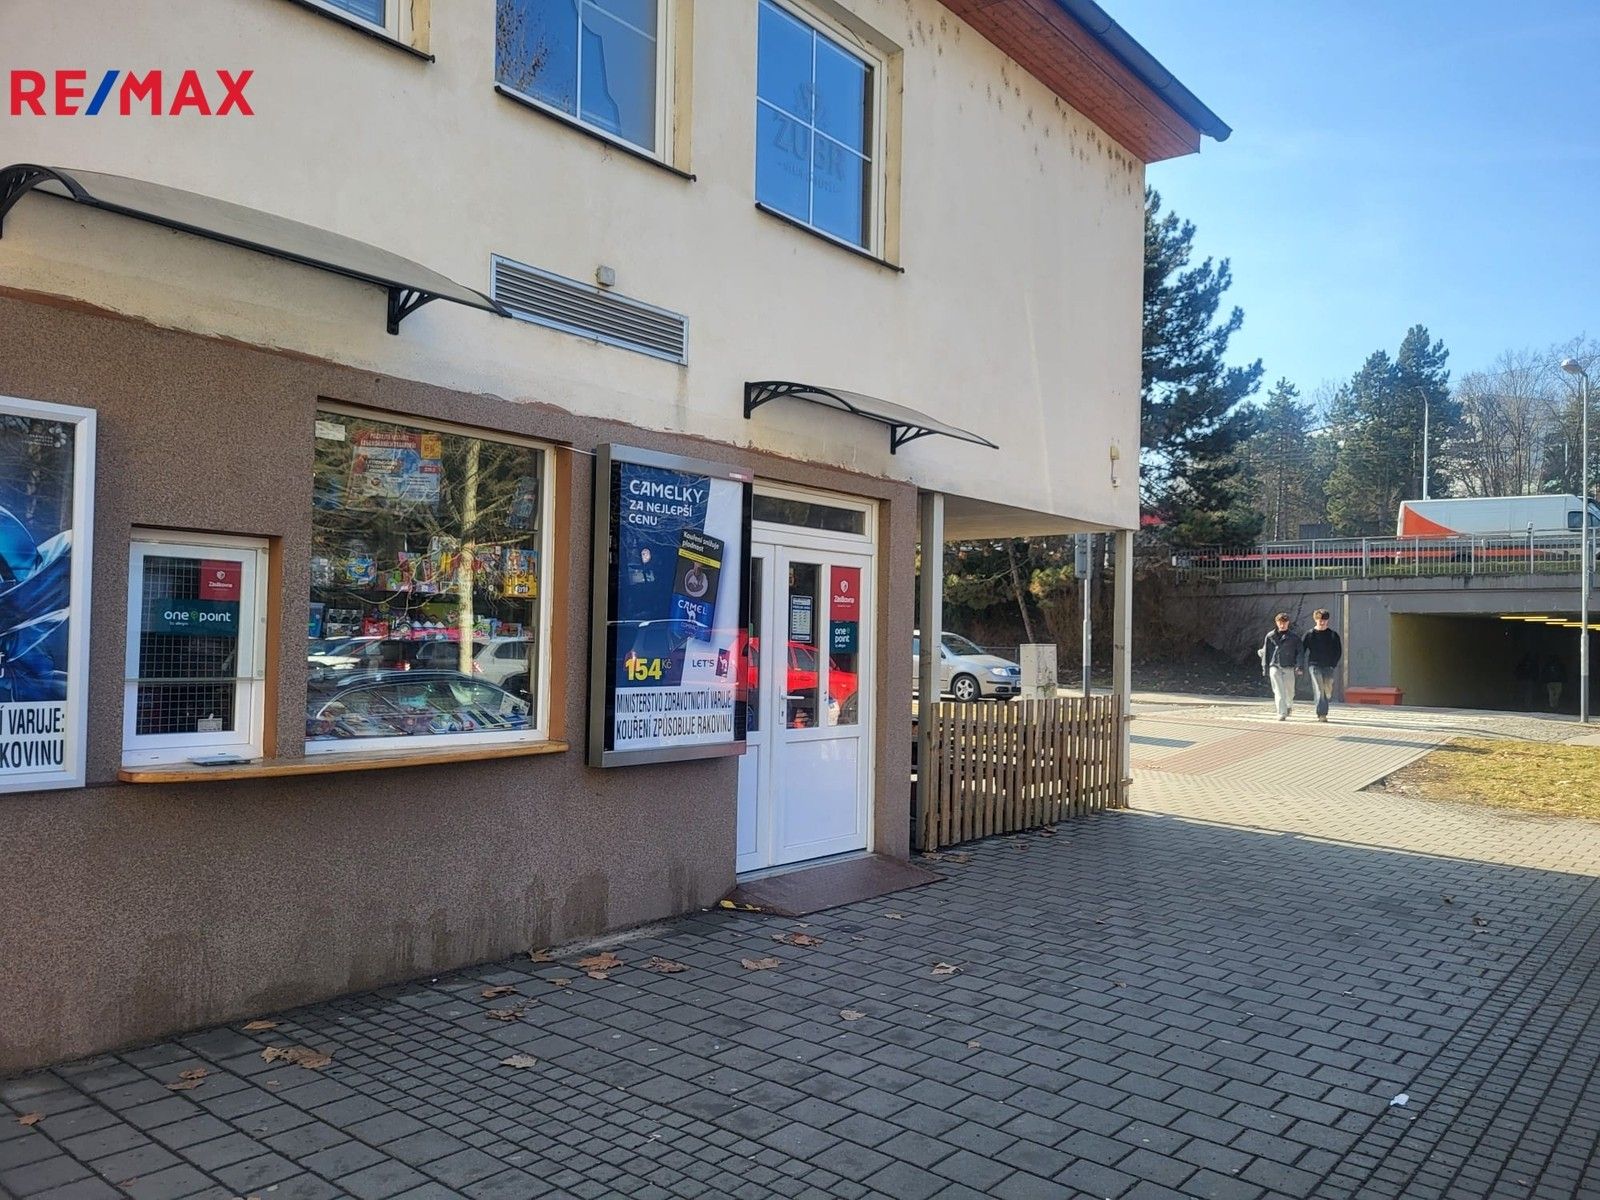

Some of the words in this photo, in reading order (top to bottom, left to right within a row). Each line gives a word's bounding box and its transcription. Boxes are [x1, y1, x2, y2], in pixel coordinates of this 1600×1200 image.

[629, 479, 704, 504] CAMELKY
[629, 500, 643, 511] ZA
[646, 503, 693, 517] NEJLEPŠÍ
[628, 513, 658, 526] CENU
[677, 599, 708, 615] CAMEL
[164, 610, 189, 621] one
[199, 611, 232, 622] point
[834, 635, 850, 643] point
[625, 658, 663, 681] 154
[662, 659, 672, 669] Kč
[692, 659, 715, 668] LET'S
[616, 693, 663, 713] MINISTERSTVO
[664, 687, 710, 711] ZDRAVOTNICTVÍ
[8, 707, 65, 735] VARUJE:
[616, 715, 651, 740] KOUŘENÍ
[653, 713, 695, 737] ZPŮSOBUJE
[697, 714, 732, 734] RAKOVINU
